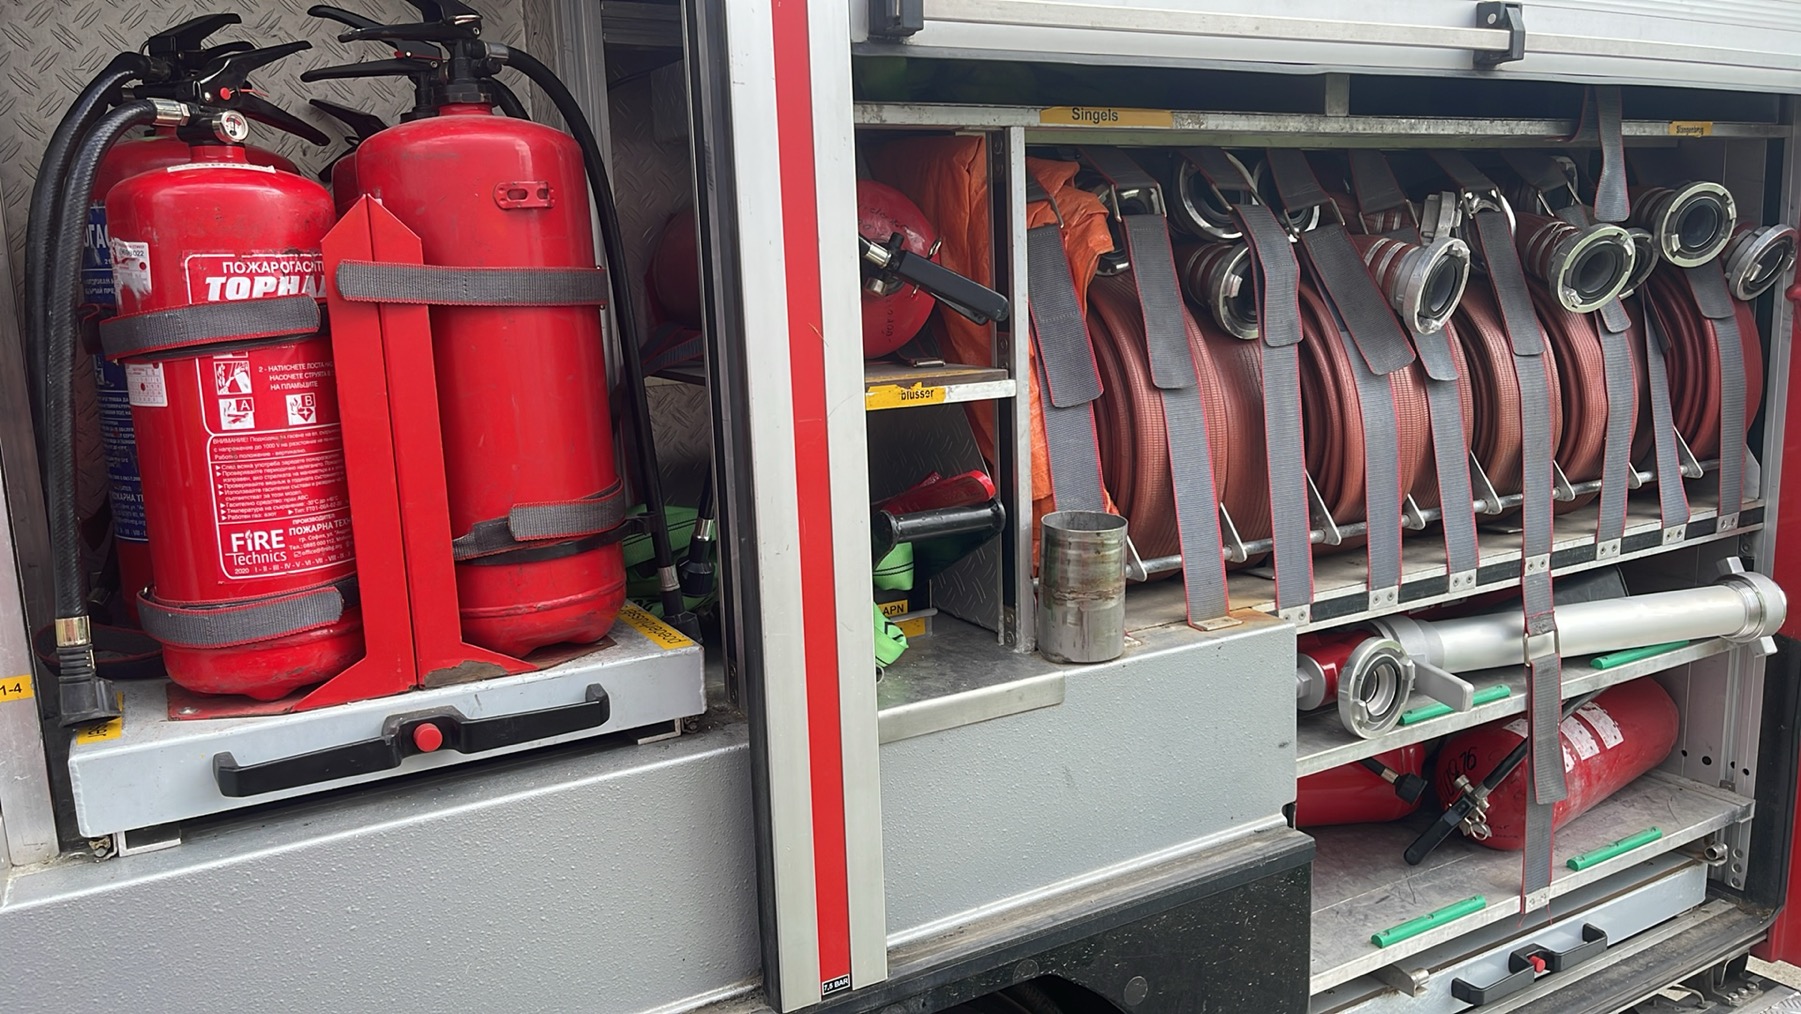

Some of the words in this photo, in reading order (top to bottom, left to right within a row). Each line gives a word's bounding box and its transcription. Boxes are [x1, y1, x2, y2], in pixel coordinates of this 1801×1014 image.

[1072, 107, 1118, 124] Singels
[268, 363, 305, 372] НАТИСНЕТЕ
[269, 373, 303, 381] НАСОЧЕТЕ
[281, 381, 318, 389] ПЛАМЪЦИТЕ
[240, 400, 250, 410] A
[305, 396, 312, 406] B
[292, 514, 335, 524] ПРОИЗВОДИТЕЛ
[289, 522, 333, 536] ПОЖАРНА
[225, 550, 287, 566] Technics
[883, 604, 904, 615] APN
[834, 978, 849, 988] BAR
